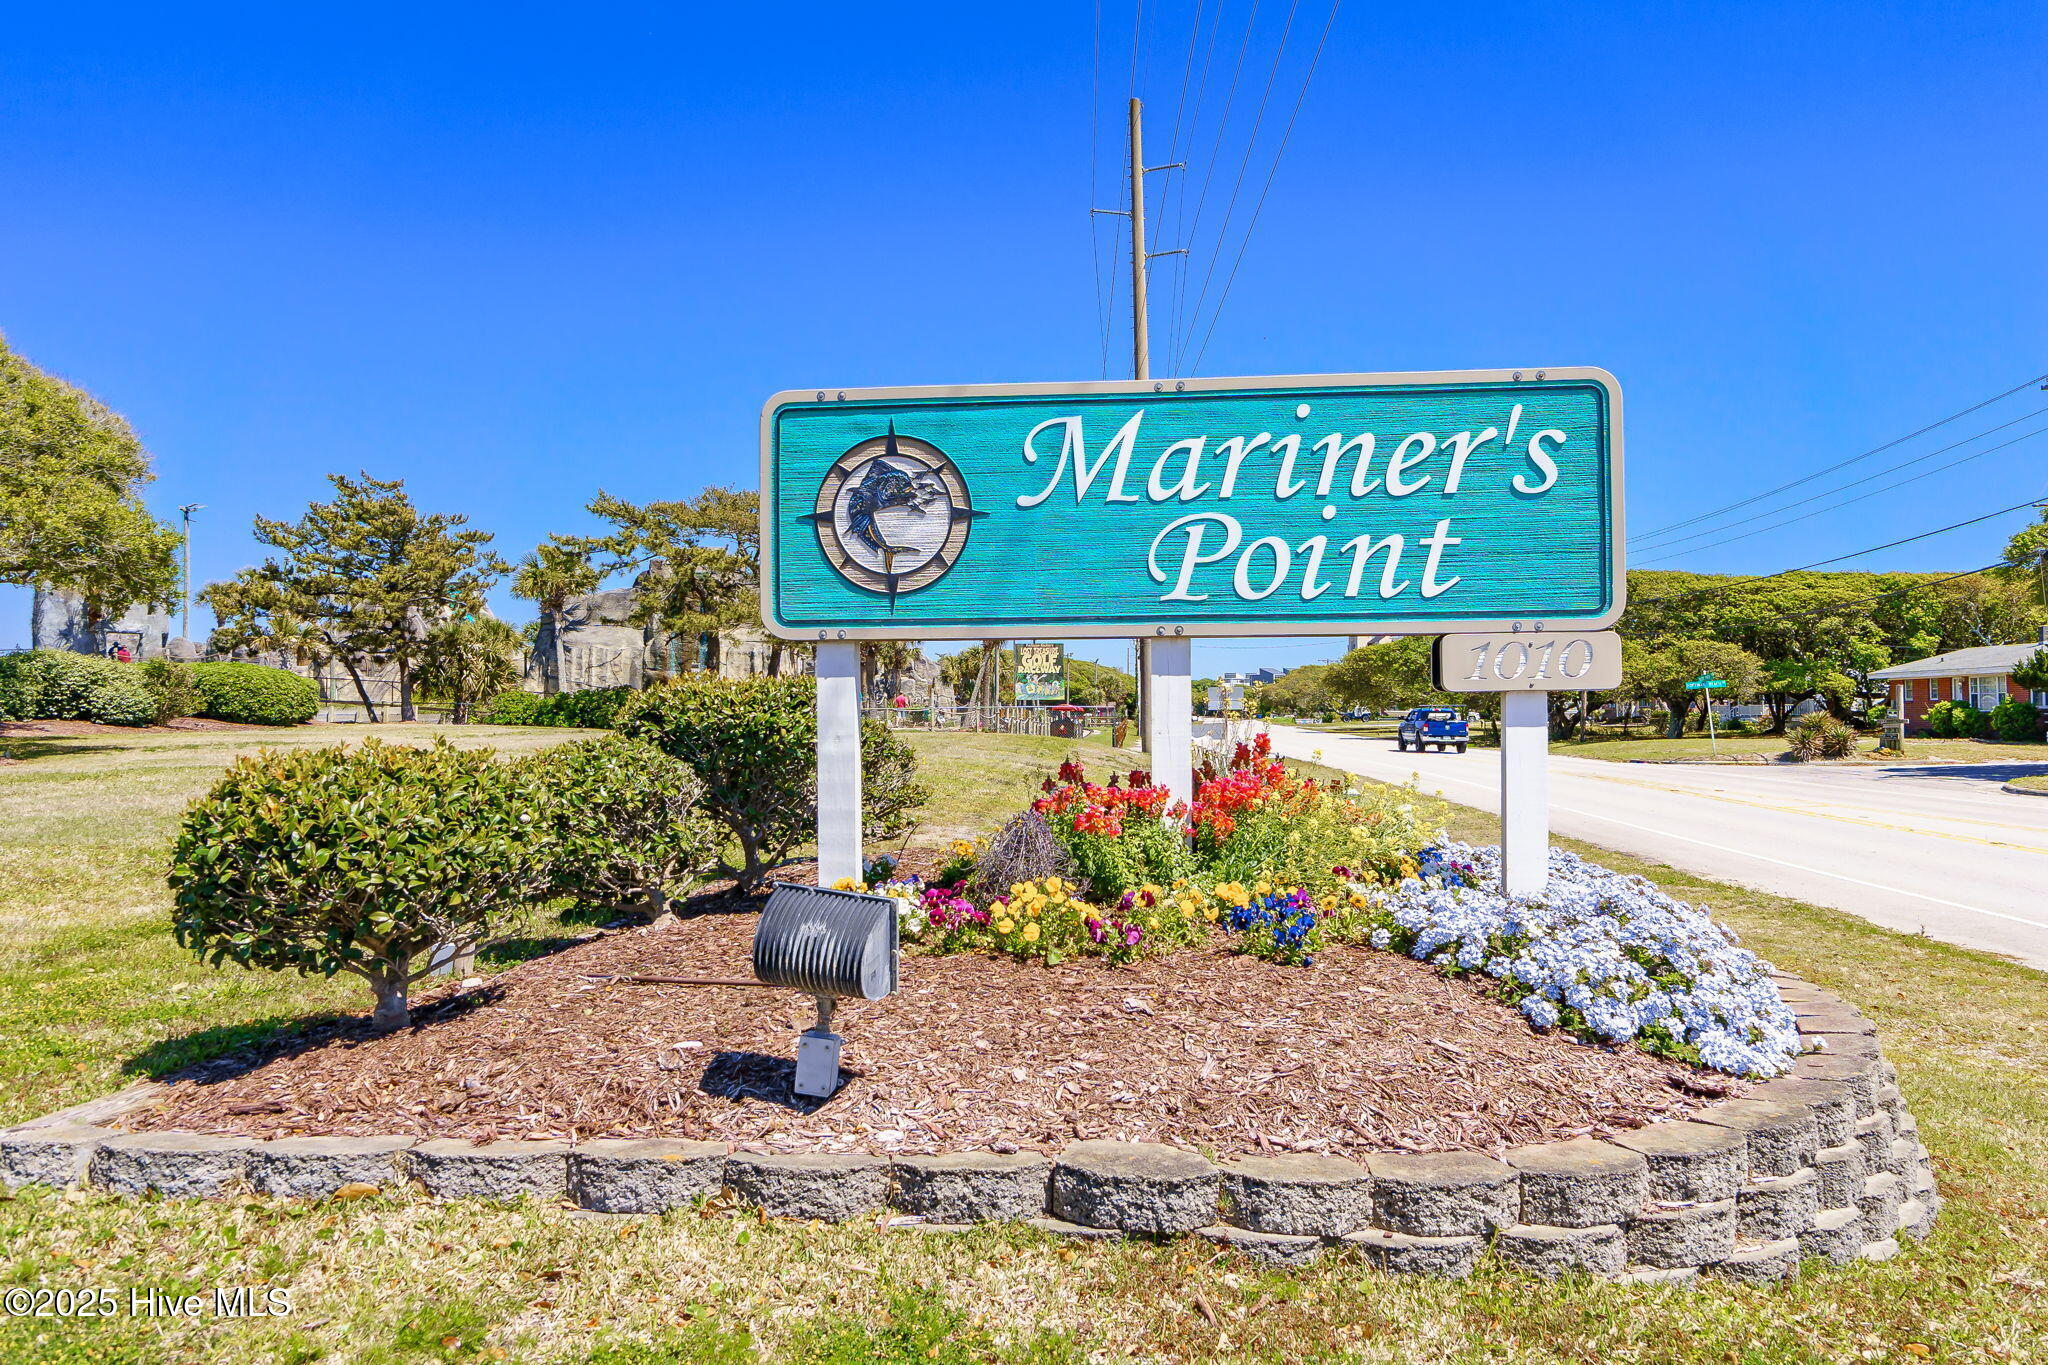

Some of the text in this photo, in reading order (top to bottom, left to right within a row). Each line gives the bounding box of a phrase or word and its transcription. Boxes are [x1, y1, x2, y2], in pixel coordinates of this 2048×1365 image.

[1016, 403, 1567, 507] Mariner's
[1148, 505, 1462, 602] Point
[1017, 665, 1062, 674] RACEWAY
[1021, 654, 1058, 667] GOLF
[1462, 639, 1594, 681] 1010
